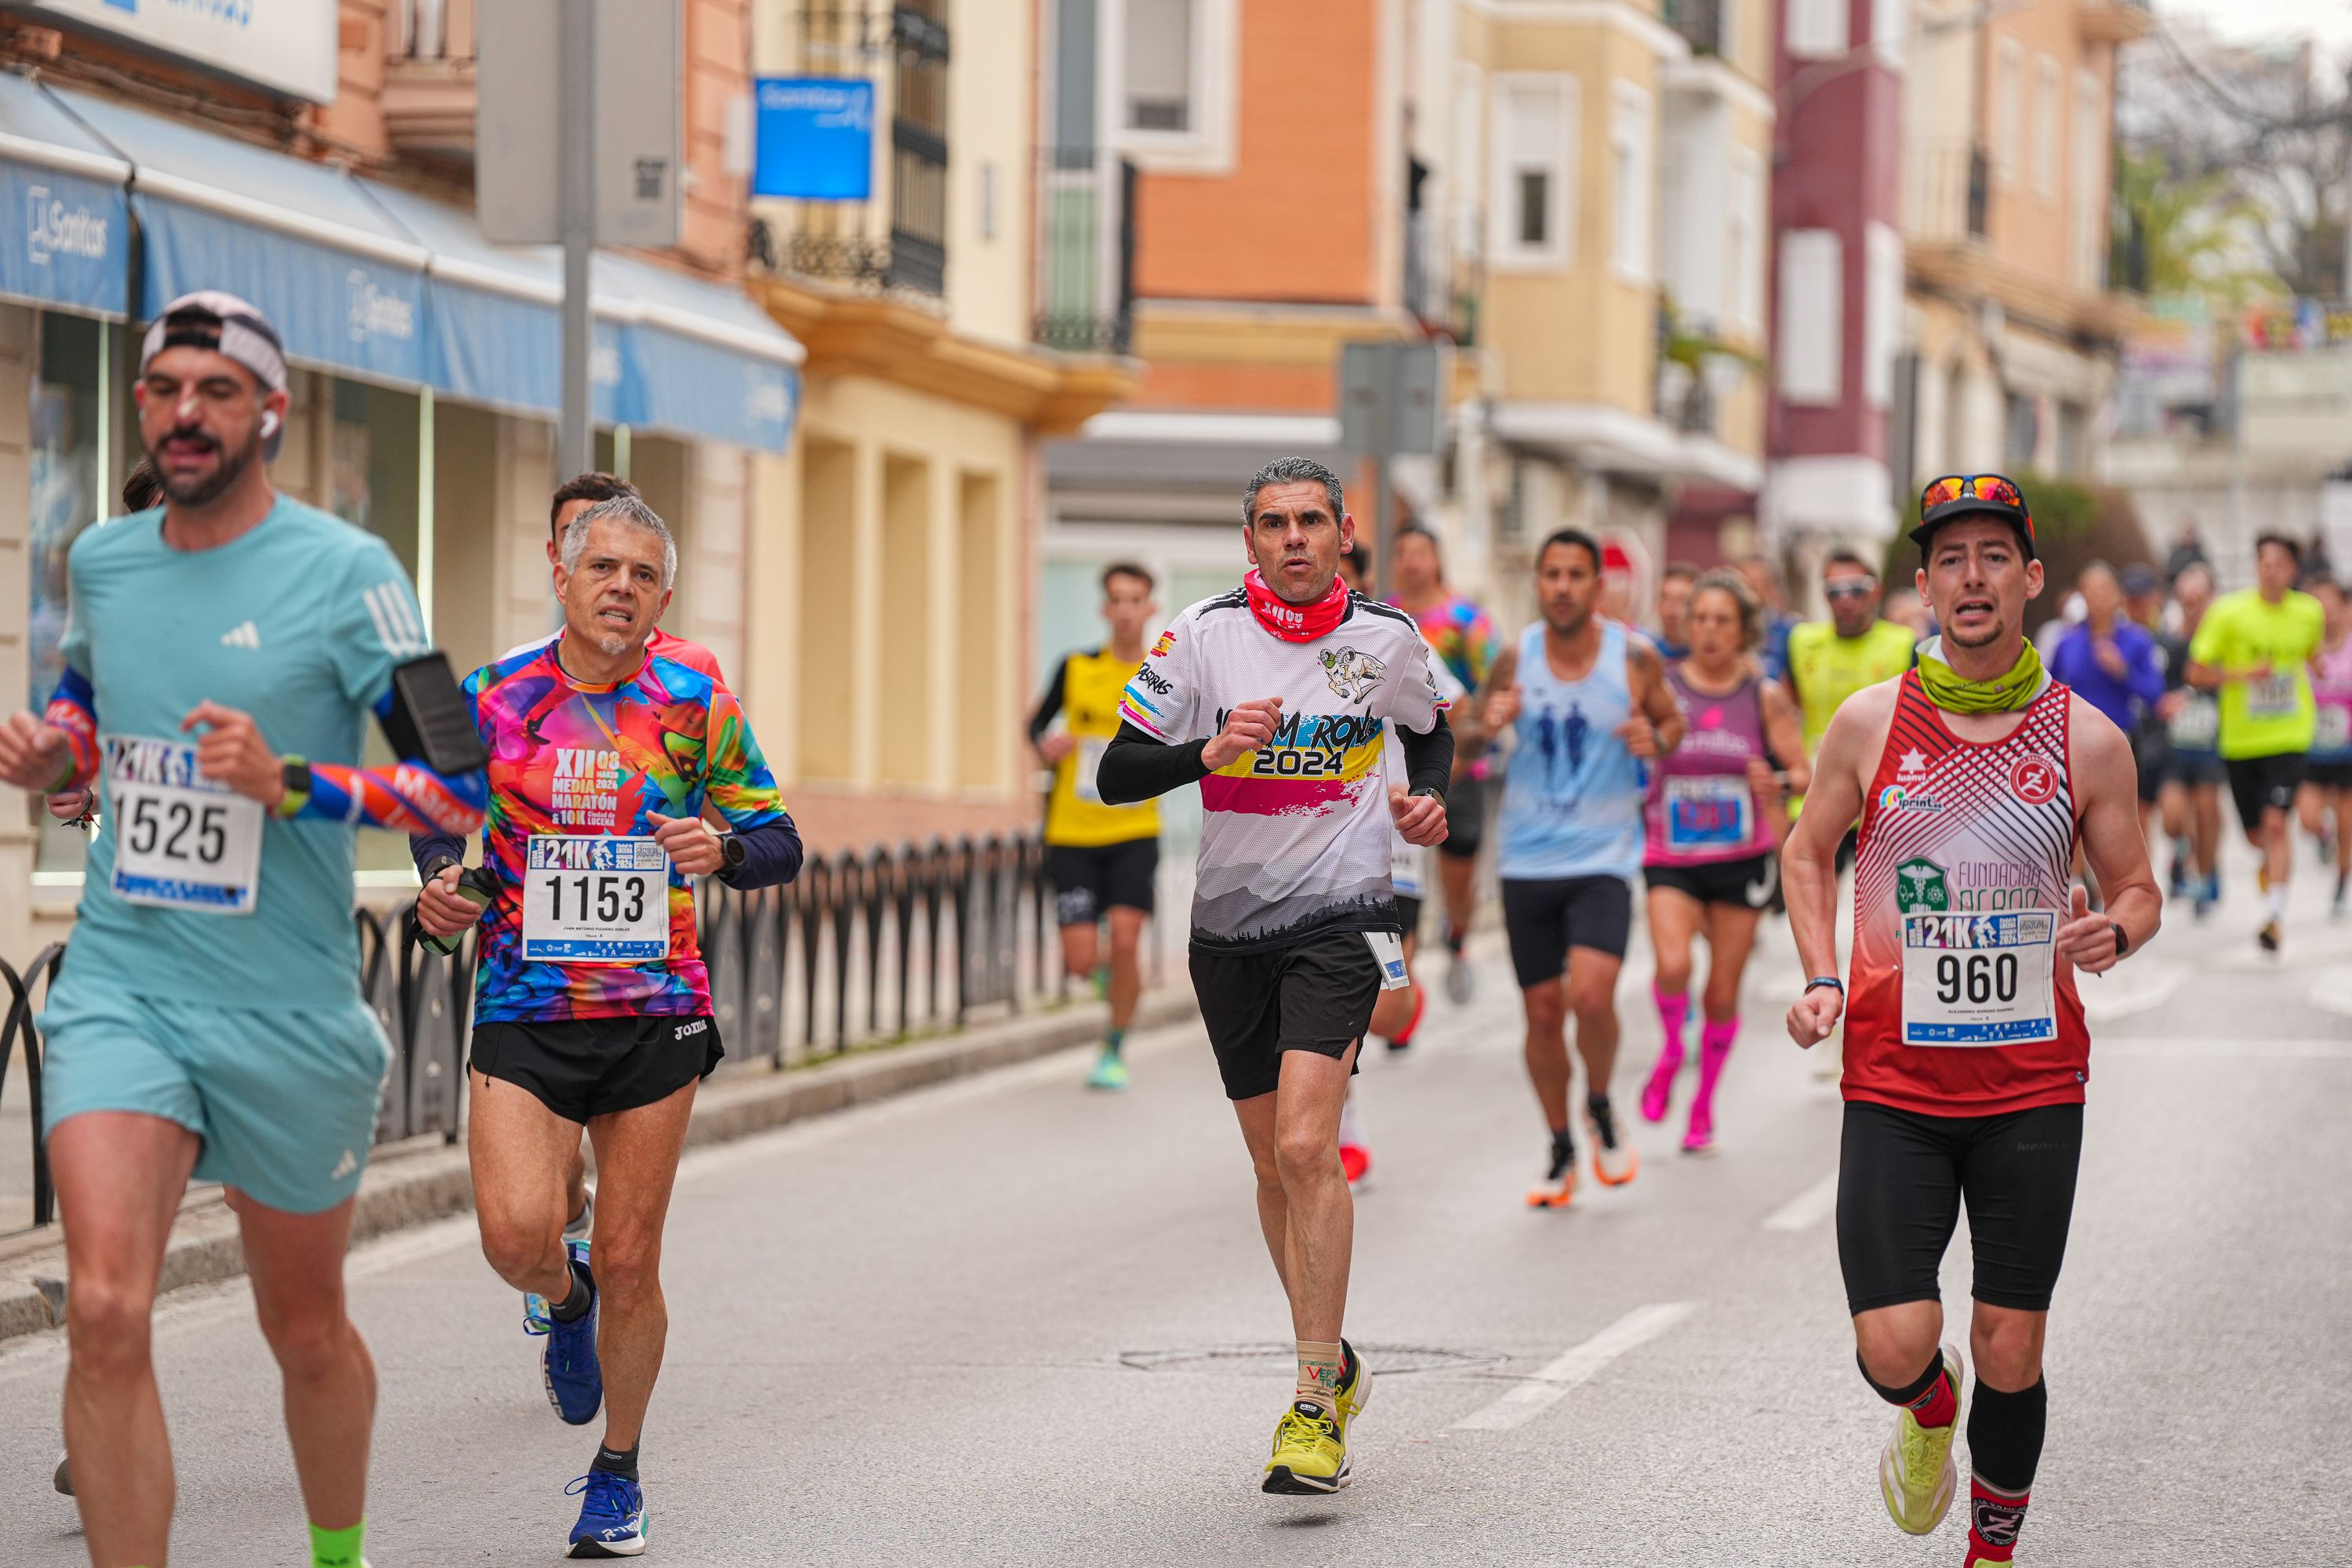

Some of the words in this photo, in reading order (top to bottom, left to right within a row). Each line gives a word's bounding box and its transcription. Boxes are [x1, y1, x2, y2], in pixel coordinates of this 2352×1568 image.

[554, 748, 596, 779] XII
[597, 750, 620, 770] 08
[1254, 750, 1343, 775] 2024
[552, 778, 595, 794] MEDIA
[596, 779, 618, 789] 2026
[552, 792, 618, 811] MARATÓN
[552, 813, 559, 824] &
[561, 809, 586, 825] 10K
[587, 817, 615, 826] LUCENA
[546, 840, 590, 869] 21K
[1958, 858, 2042, 887] FUNDACIÓN
[546, 876, 644, 922] 1153
[1925, 916, 1973, 948] 21K
[1937, 953, 2018, 1004] 960
